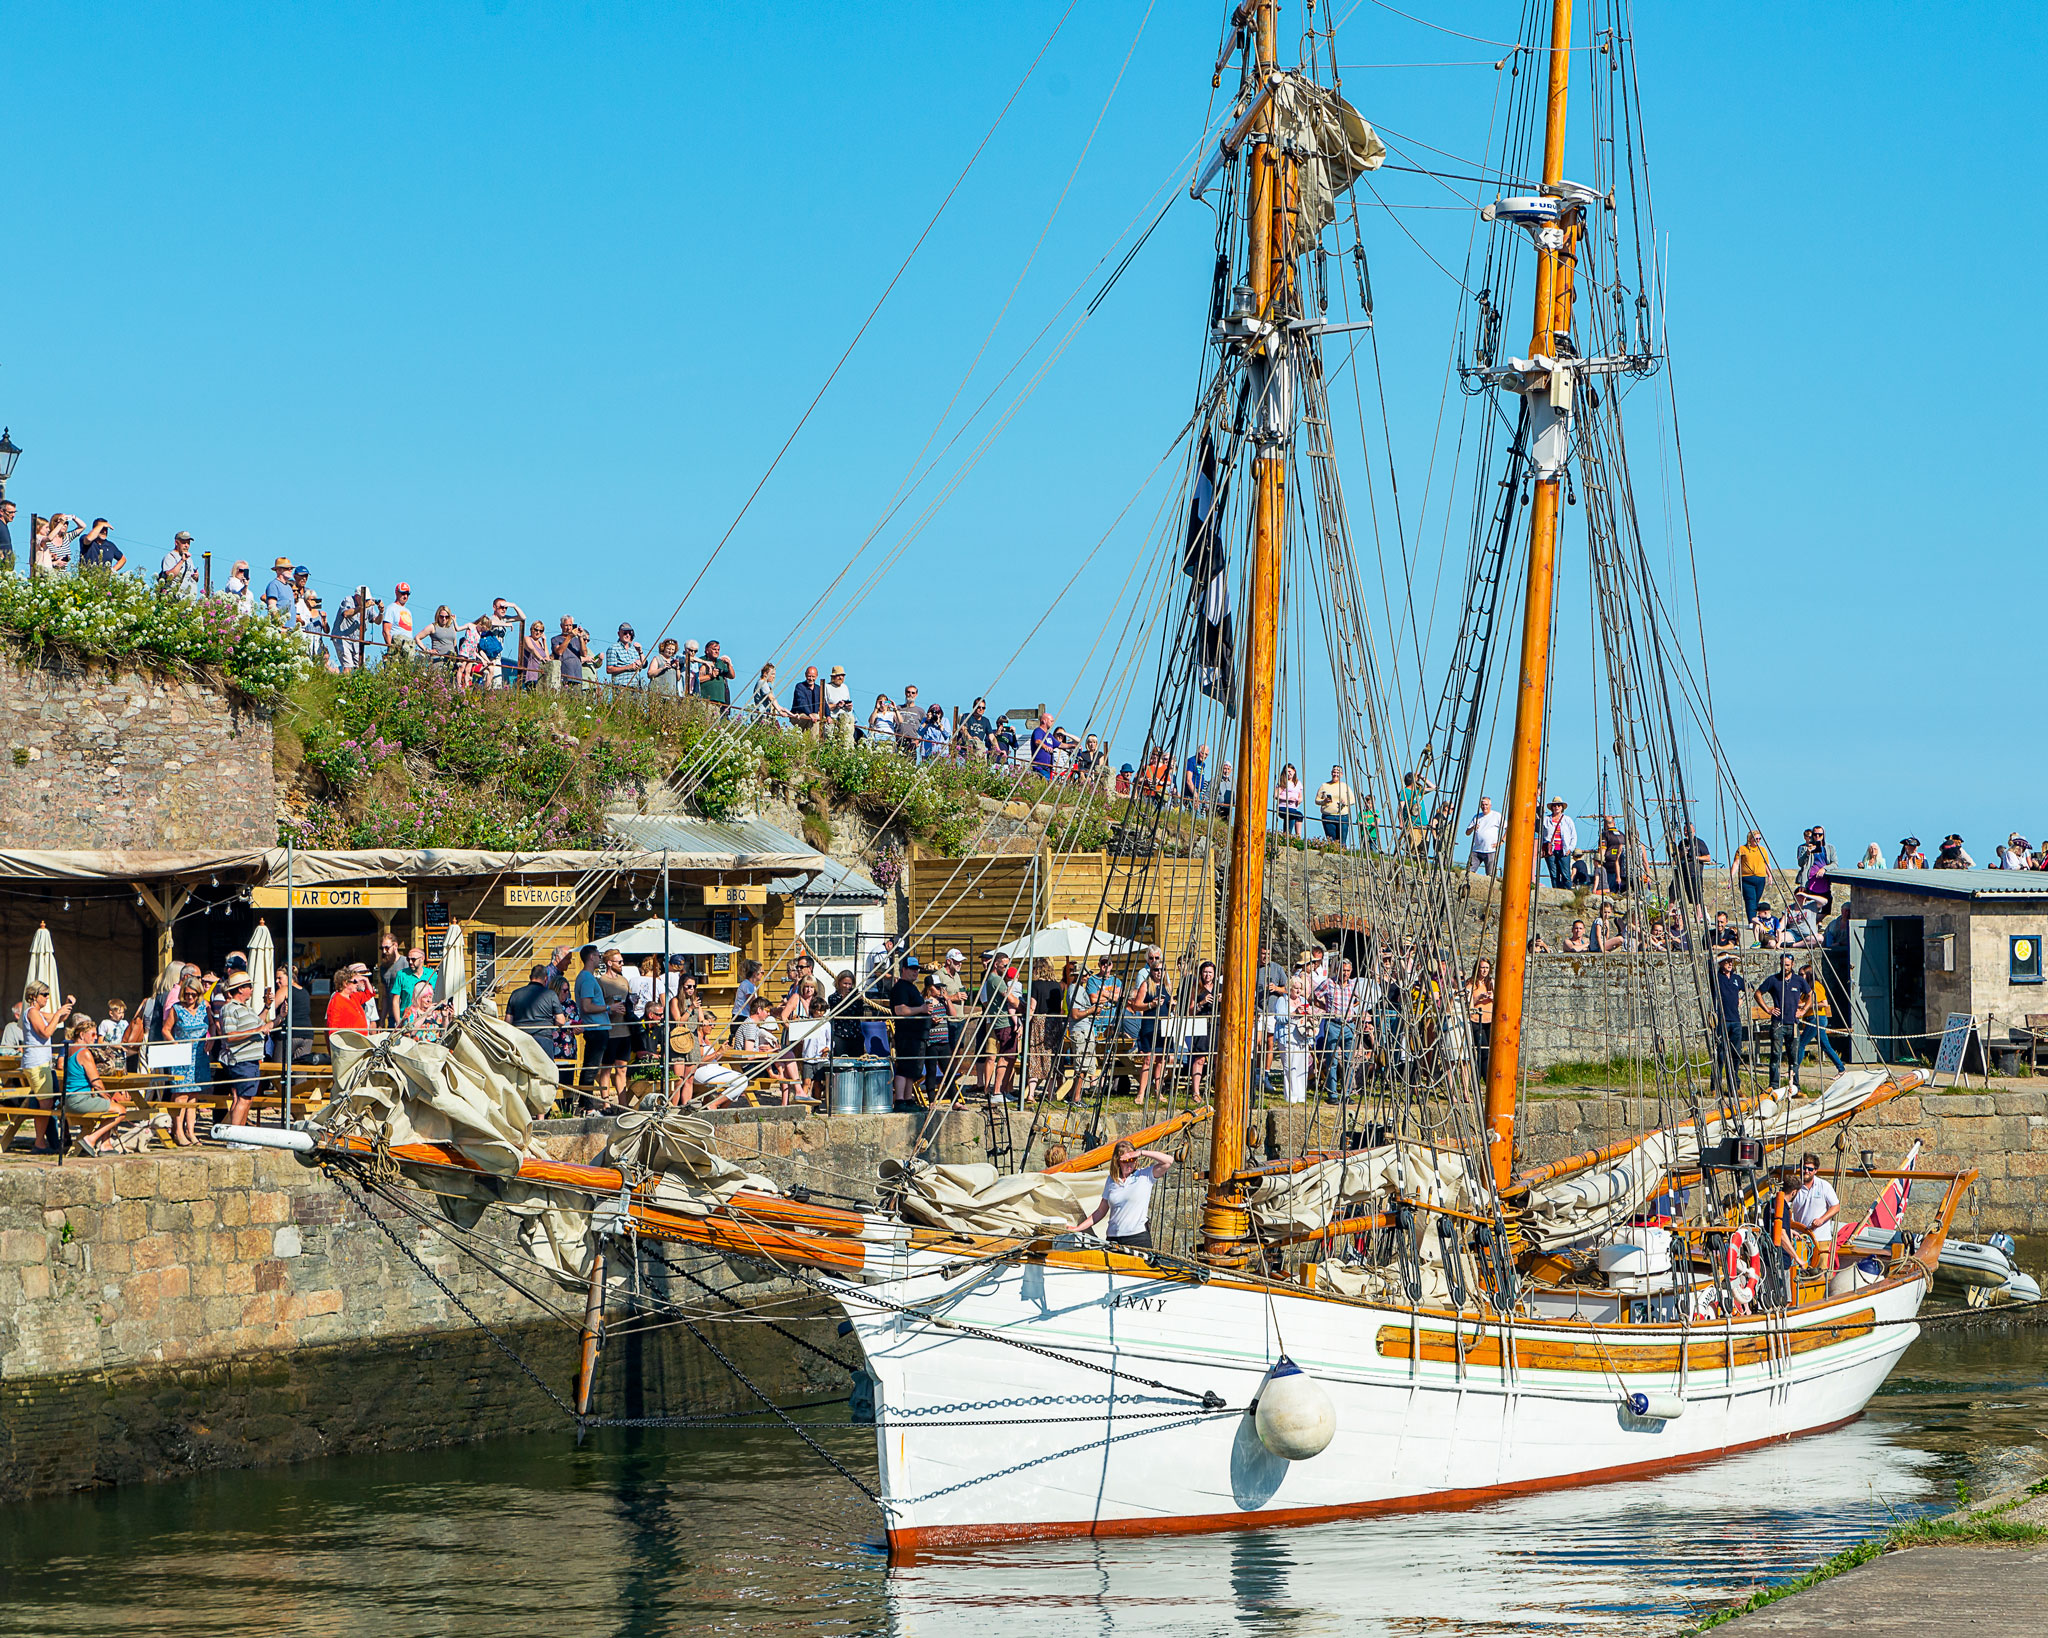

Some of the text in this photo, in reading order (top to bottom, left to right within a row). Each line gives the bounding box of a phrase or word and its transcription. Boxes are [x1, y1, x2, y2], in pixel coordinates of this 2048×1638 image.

[510, 890, 572, 902] BEVERAGES
[727, 889, 746, 902] BBQ
[1109, 1294, 1167, 1312] ANNY
